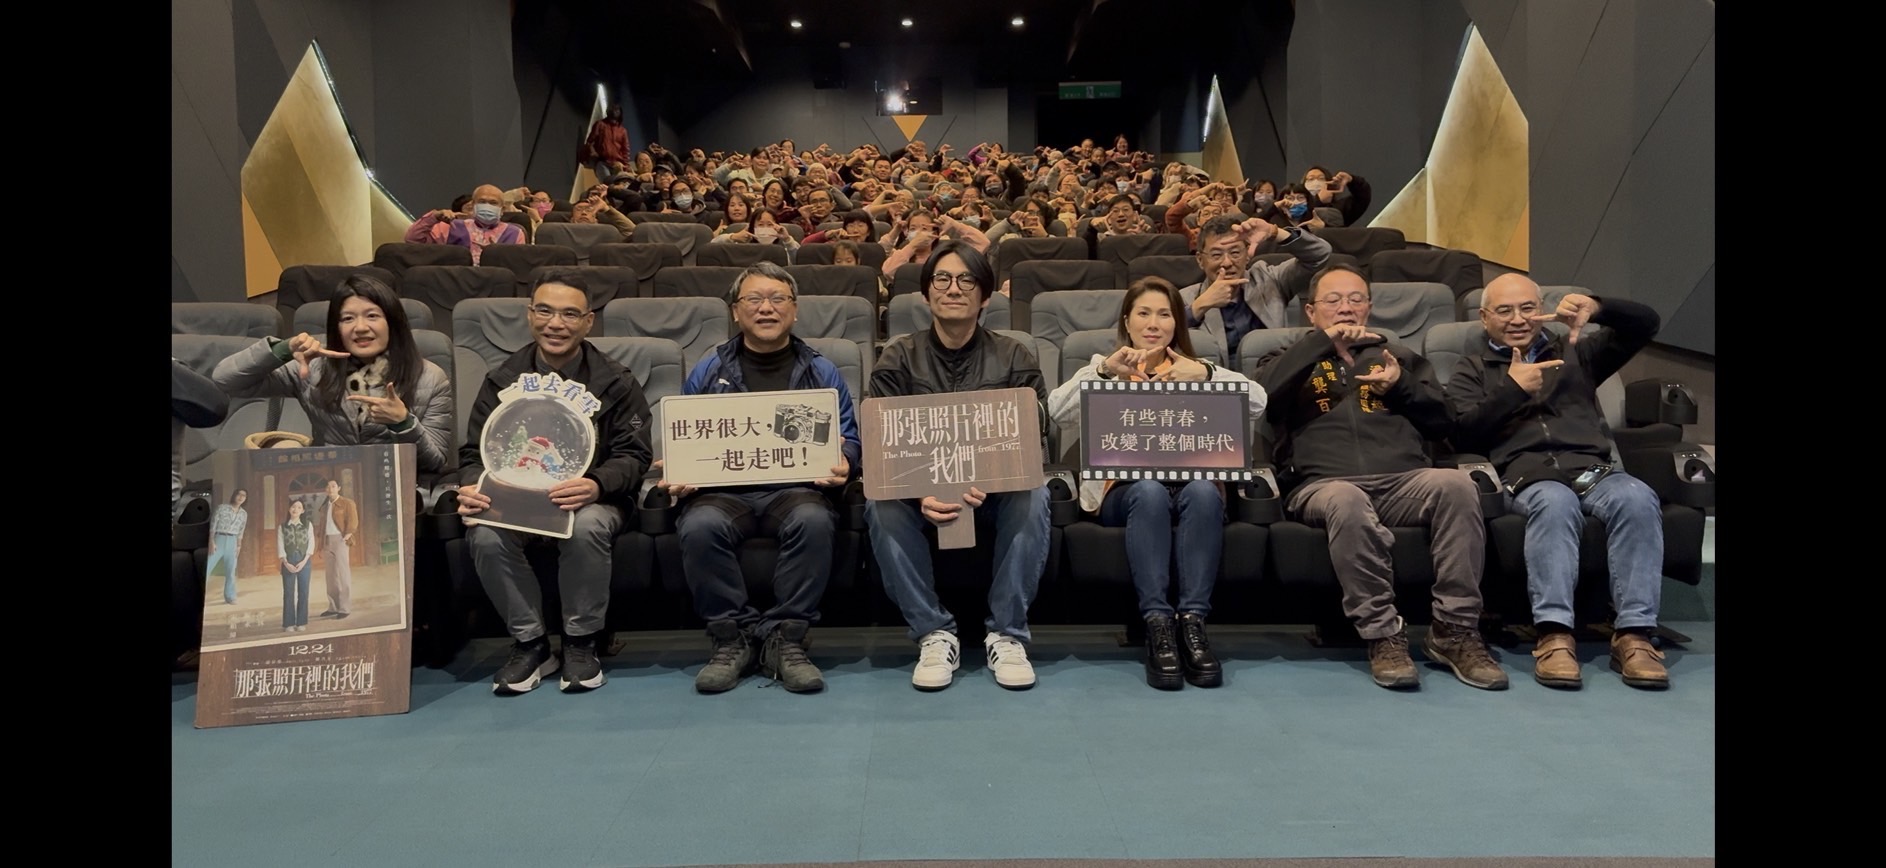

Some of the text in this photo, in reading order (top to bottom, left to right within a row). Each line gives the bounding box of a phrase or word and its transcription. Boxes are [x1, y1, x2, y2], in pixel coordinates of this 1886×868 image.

[499, 375, 599, 414] 一起去看雪
[669, 416, 773, 441] 世界很大，
[881, 401, 1020, 447] 那張照片裡的
[1119, 408, 1209, 428] 有些青春，
[1100, 432, 1235, 453] 改變了整個時代
[695, 446, 808, 472] 一起走吧！
[883, 451, 898, 460] The
[928, 442, 976, 485] 我們
[288, 643, 335, 656] 12.24
[236, 658, 374, 698] 那張照片裡的我們
